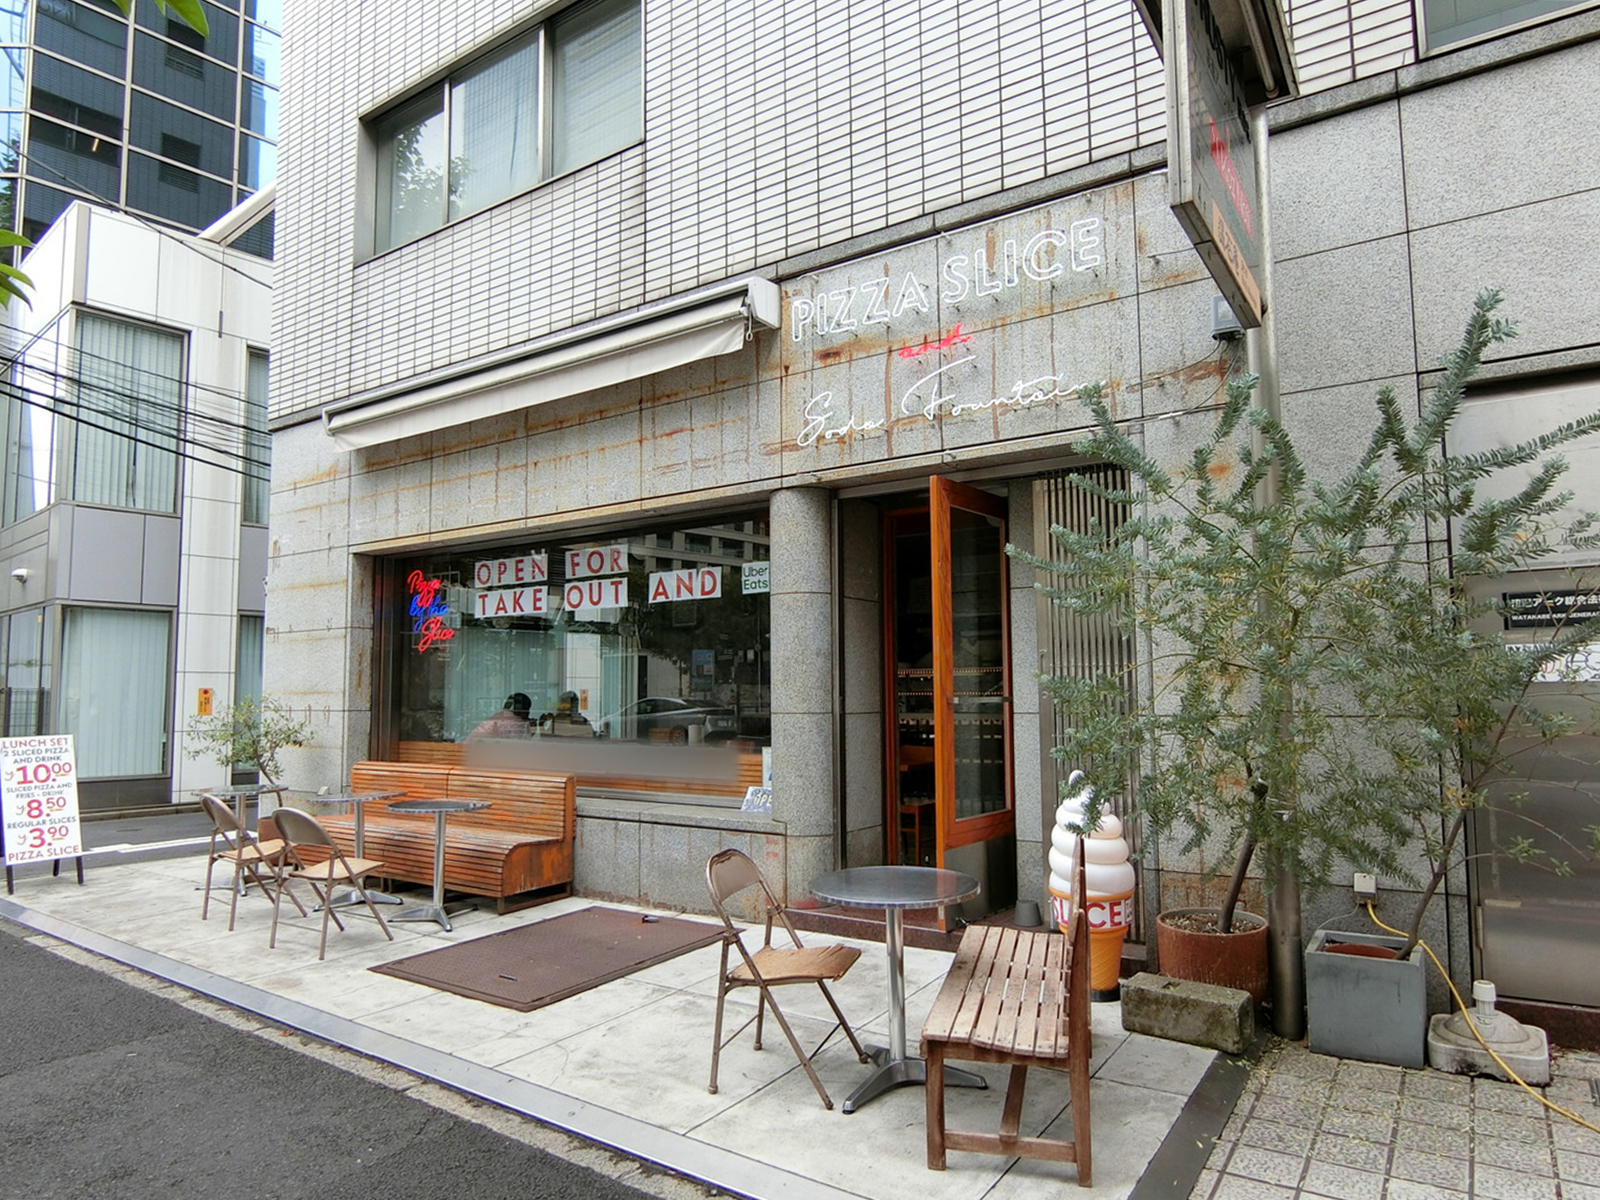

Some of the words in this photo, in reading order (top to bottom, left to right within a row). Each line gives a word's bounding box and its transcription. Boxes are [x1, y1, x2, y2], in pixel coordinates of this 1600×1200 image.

[792, 272, 928, 341] PIZZA
[942, 217, 1100, 303] SLICE
[898, 323, 971, 359] and
[797, 391, 884, 446] Soda
[476, 557, 546, 586] OPEN
[570, 547, 623, 577] FOR
[743, 567, 768, 578] Uber
[407, 569, 442, 608] Pizza
[478, 588, 543, 616] TAKE
[566, 580, 623, 609] OUT
[652, 569, 718, 601] AND
[743, 579, 769, 590] Eats
[418, 616, 455, 651] Slice
[2, 738, 47, 749] LUNCH
[50, 737, 69, 747] SET
[12, 748, 43, 757] SLICED
[45, 747, 70, 755] PIZZA
[35, 755, 62, 763] DRINK
[6, 785, 33, 793] SLICED
[7, 819, 47, 829] REGULAR
[49, 816, 76, 825] SLICES
[8, 850, 44, 862] PIZZA
[47, 845, 79, 857] SLICE
[1052, 895, 1122, 928] SLCE
